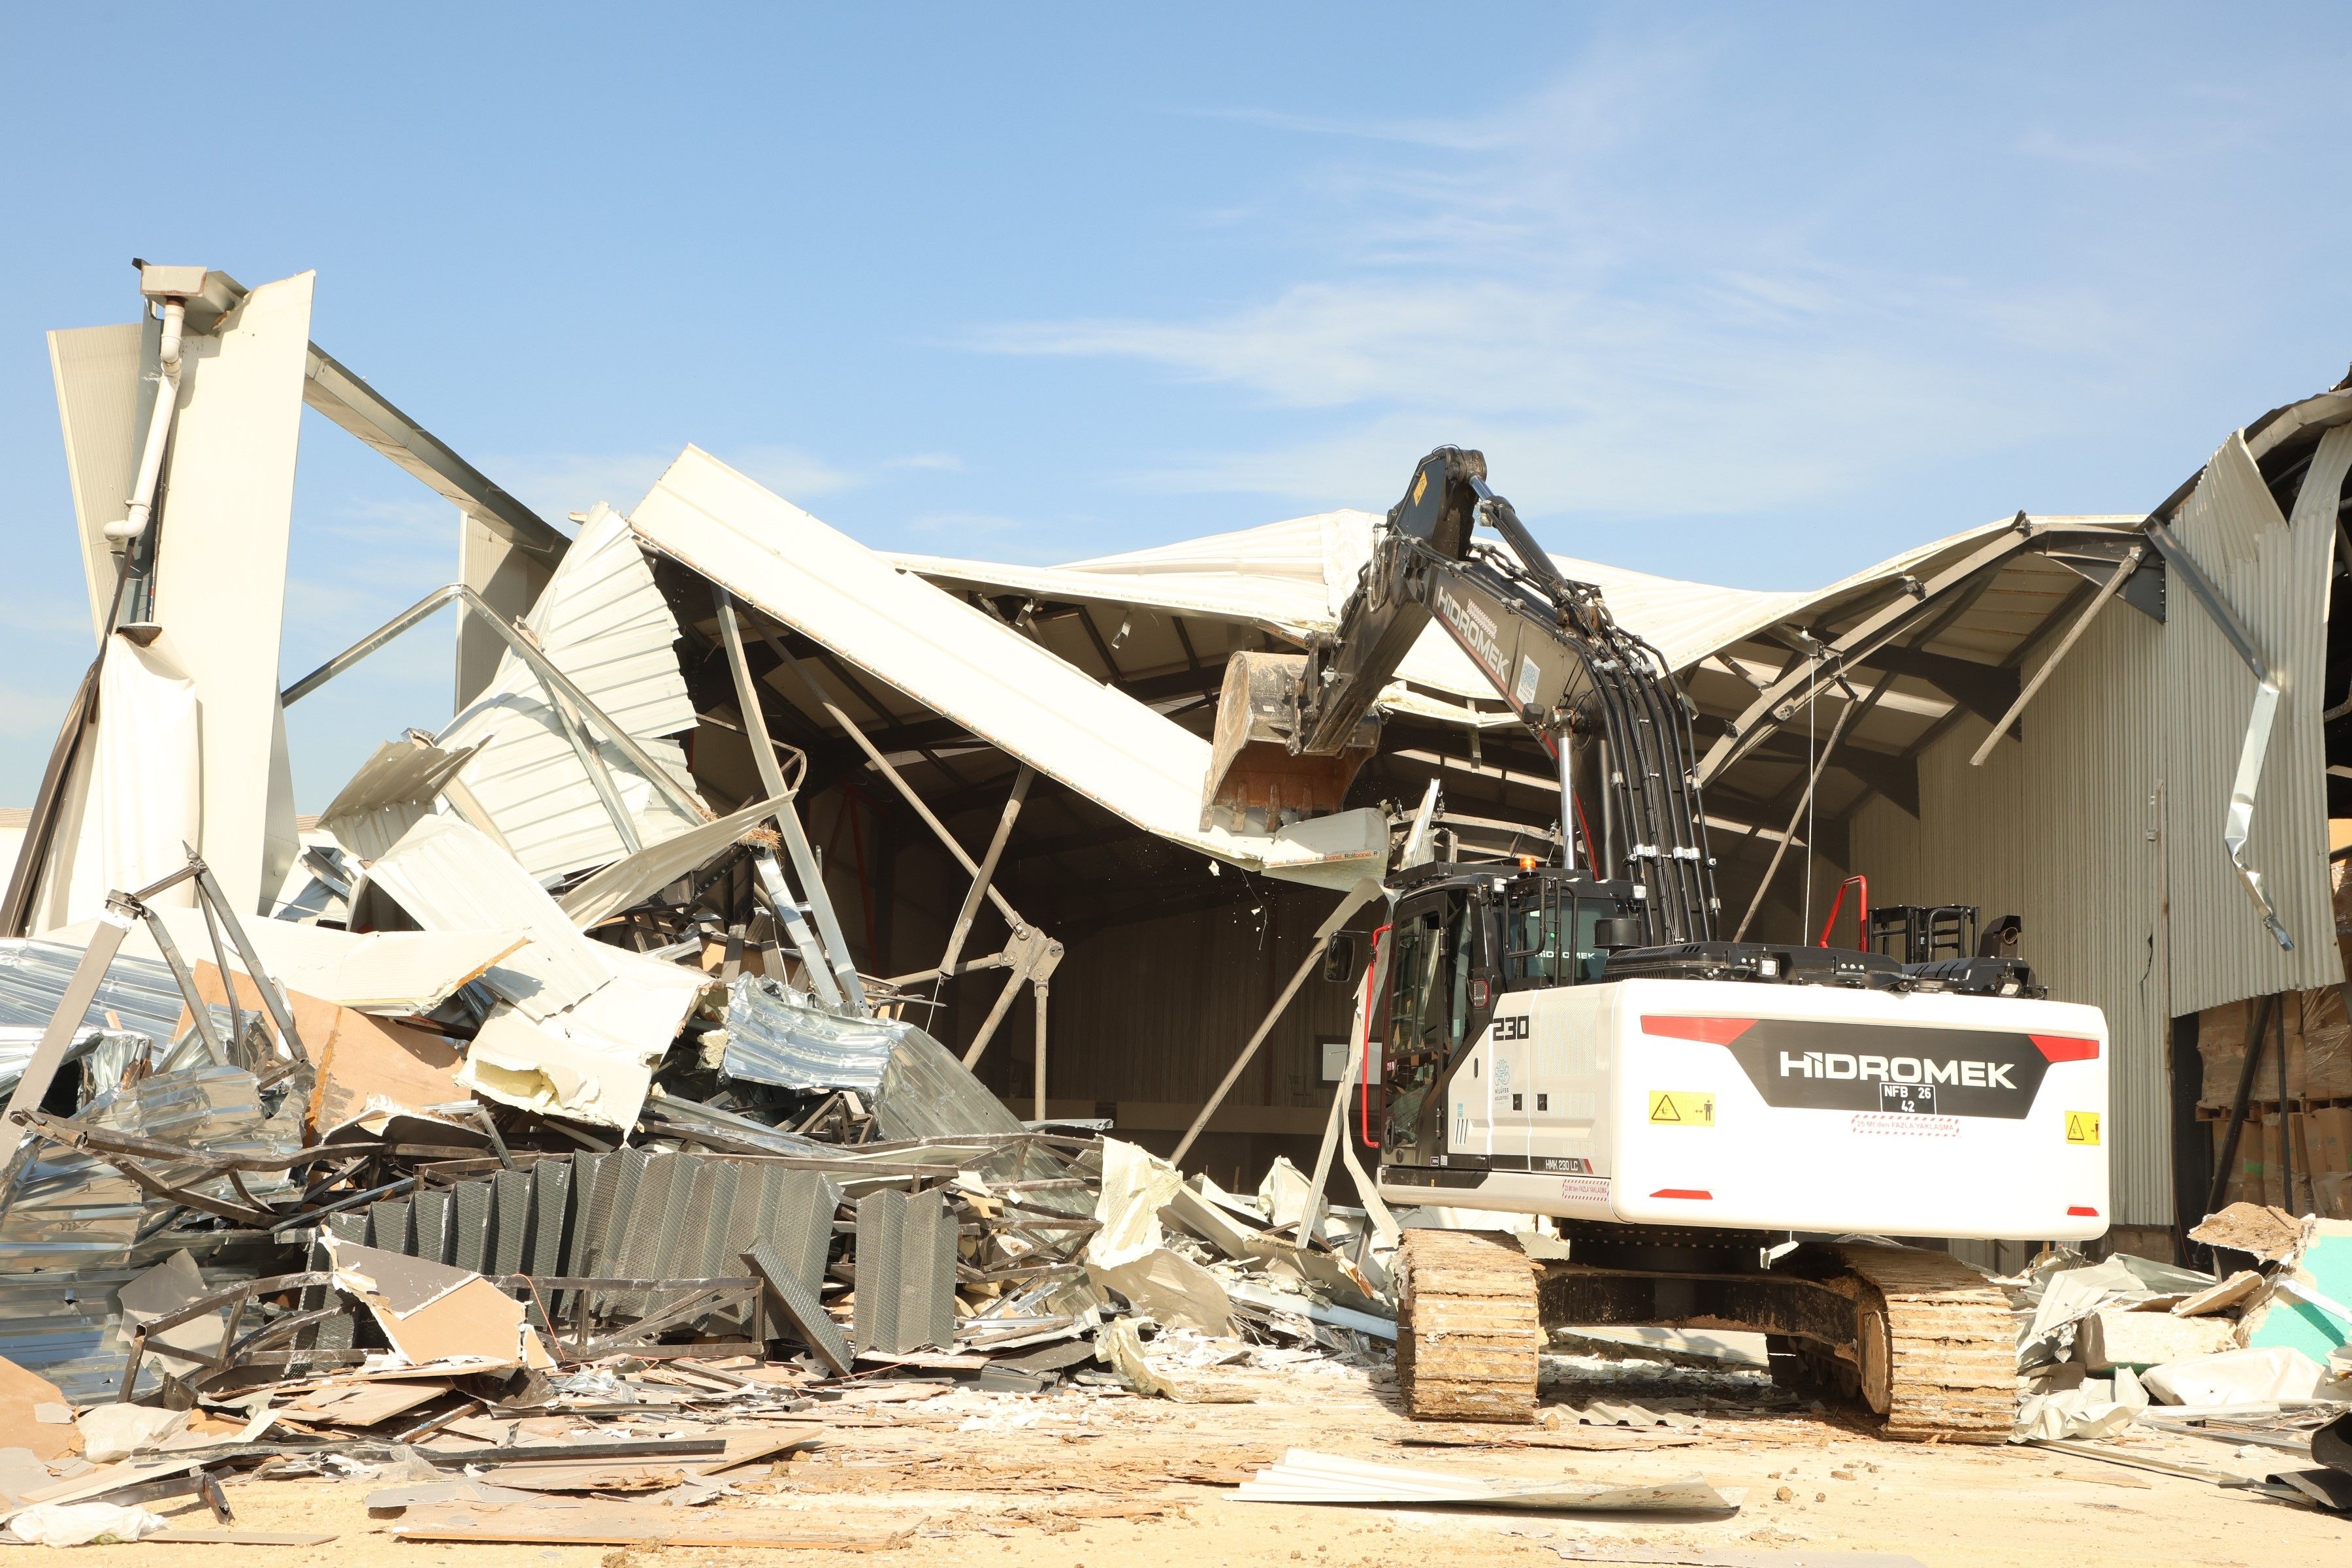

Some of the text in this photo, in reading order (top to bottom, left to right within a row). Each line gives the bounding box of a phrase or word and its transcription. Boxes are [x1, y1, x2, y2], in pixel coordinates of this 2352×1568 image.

[1493, 1015, 1529, 1041] 230
[1884, 1085, 1931, 1099] NFB 26
[1901, 1100, 1915, 1113] 42
[1545, 1159, 1578, 1171] HMK 230 LC
